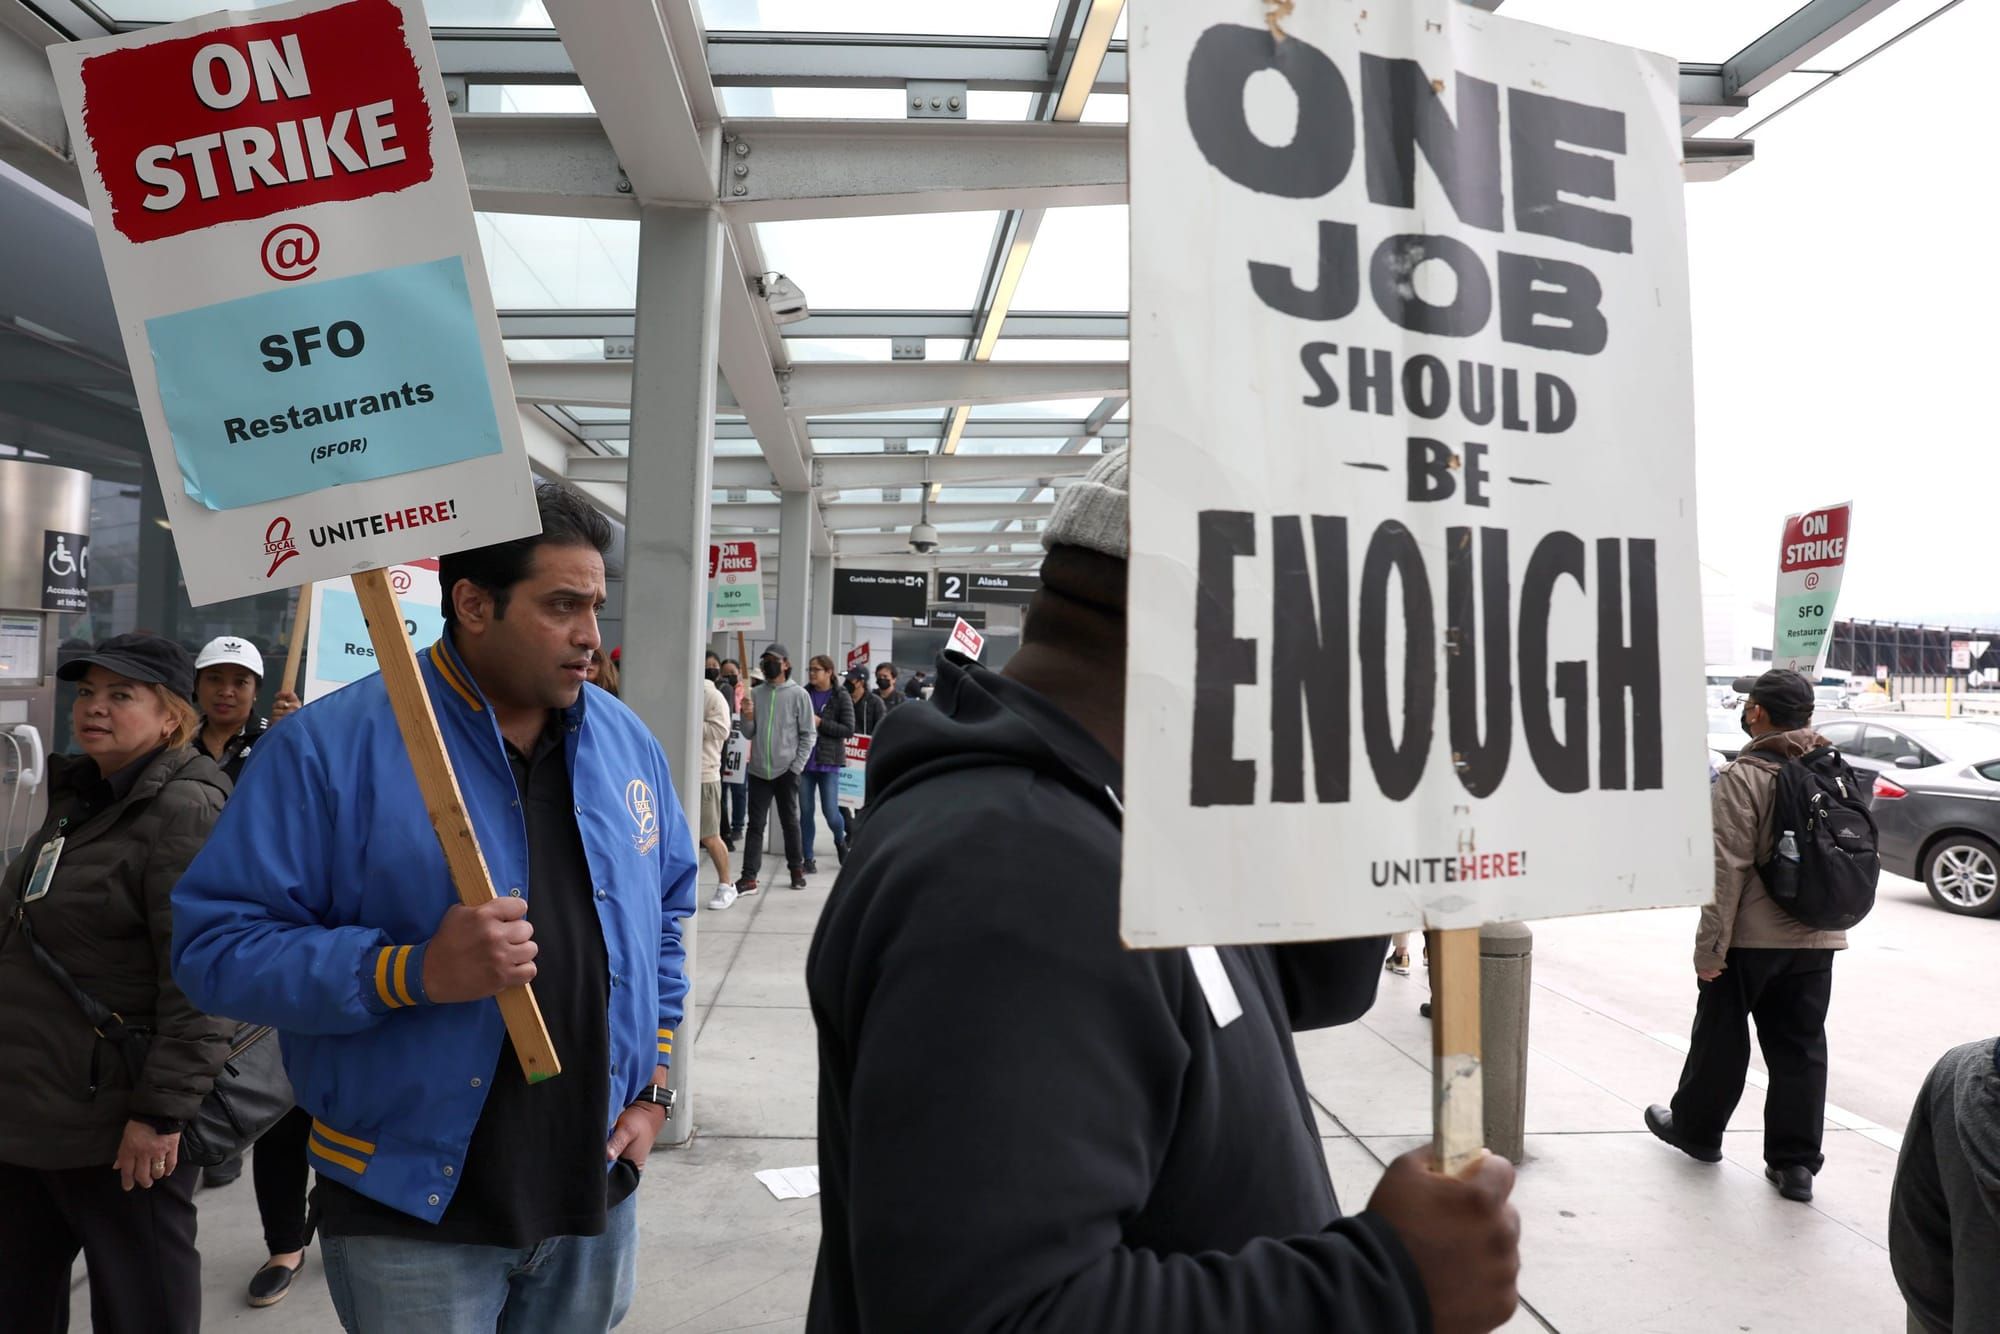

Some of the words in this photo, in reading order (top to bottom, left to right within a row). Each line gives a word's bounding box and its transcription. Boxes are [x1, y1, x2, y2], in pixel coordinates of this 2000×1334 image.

[191, 34, 311, 111] ON
[134, 99, 406, 212] STRIKE
[1184, 22, 1634, 254] ONE
[260, 223, 320, 282] @
[1247, 221, 1609, 356] JOB
[259, 320, 365, 373] SFO
[1302, 342, 1577, 434] SHOULD
[224, 381, 435, 444] Restaurants
[309, 437, 368, 464] (SFOR)
[1406, 436, 1491, 508] BE
[1802, 514, 1829, 537] ON
[265, 539, 296, 553] LOCAL
[1786, 537, 1844, 565] STRIKE
[390, 570, 411, 594] @
[849, 576, 876, 584] Curbside
[944, 577, 961, 598] 2
[977, 576, 1009, 587] Alaska
[1805, 572, 1819, 590] @
[1798, 605, 1824, 618] SFO
[1189, 510, 1665, 808] ENOUGH
[1371, 851, 1527, 887] UNITEHERE!
